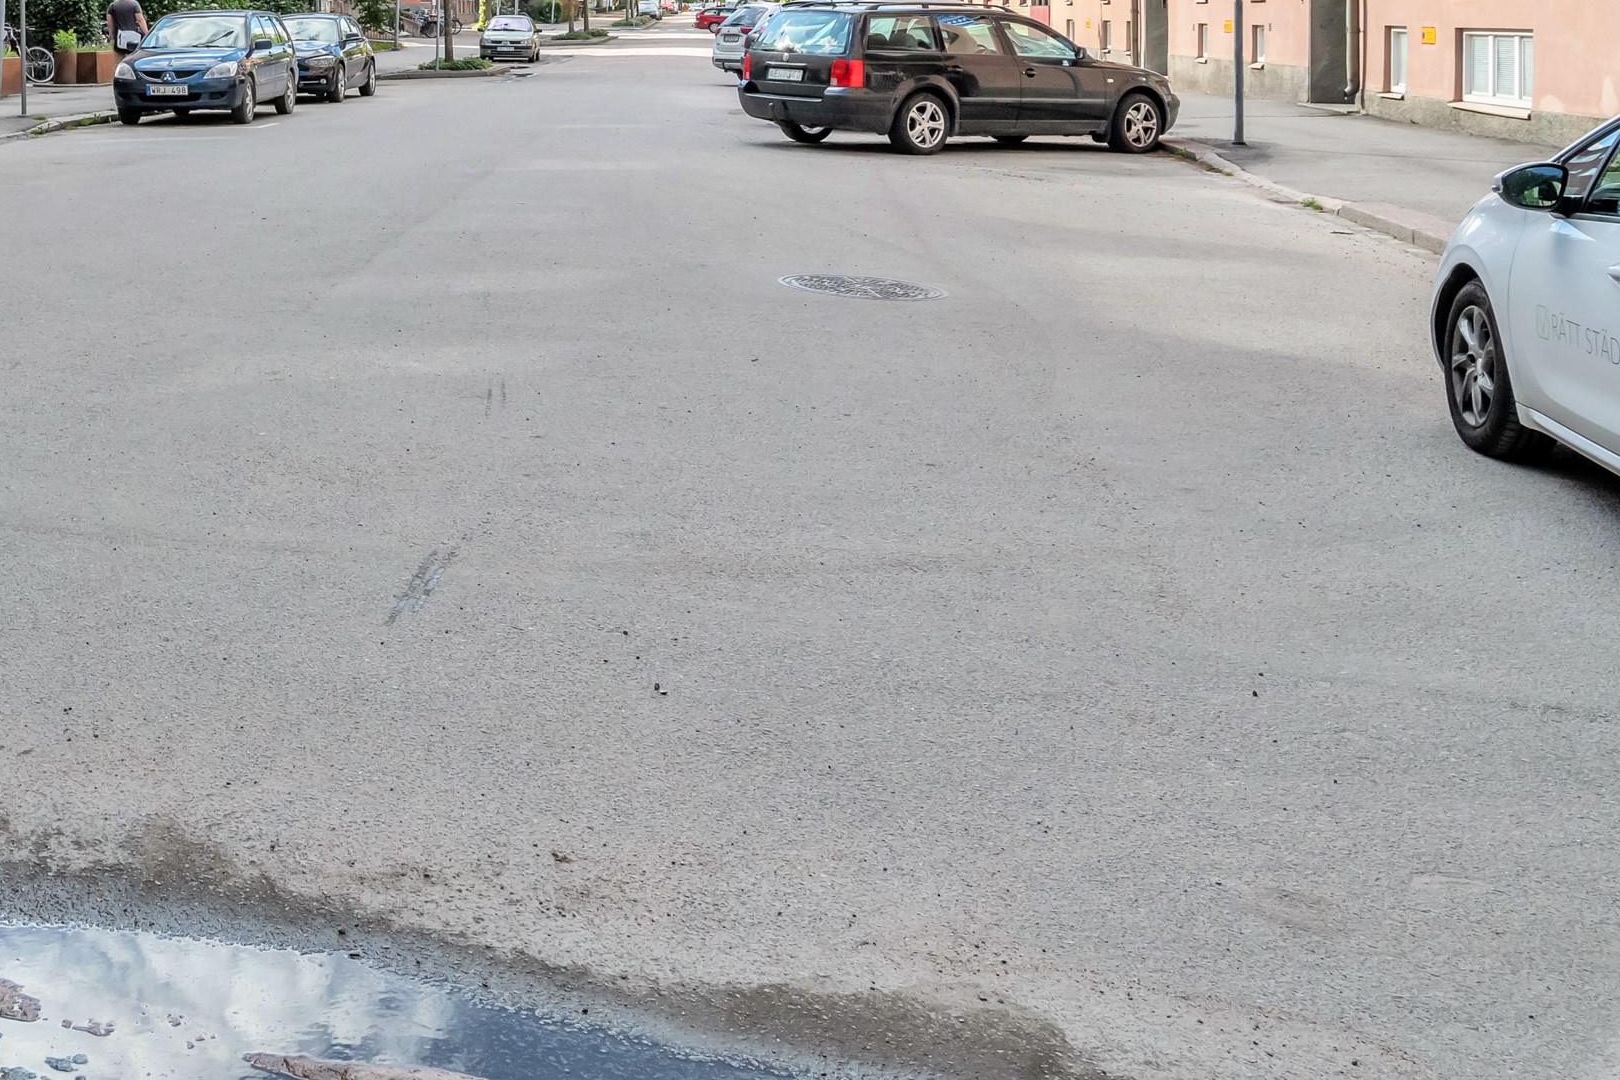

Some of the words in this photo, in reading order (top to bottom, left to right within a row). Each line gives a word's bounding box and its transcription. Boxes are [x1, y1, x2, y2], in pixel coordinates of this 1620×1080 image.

[151, 86, 166, 94] WRJ
[171, 86, 187, 94] 498
[1551, 312, 1580, 349] RÄTT
